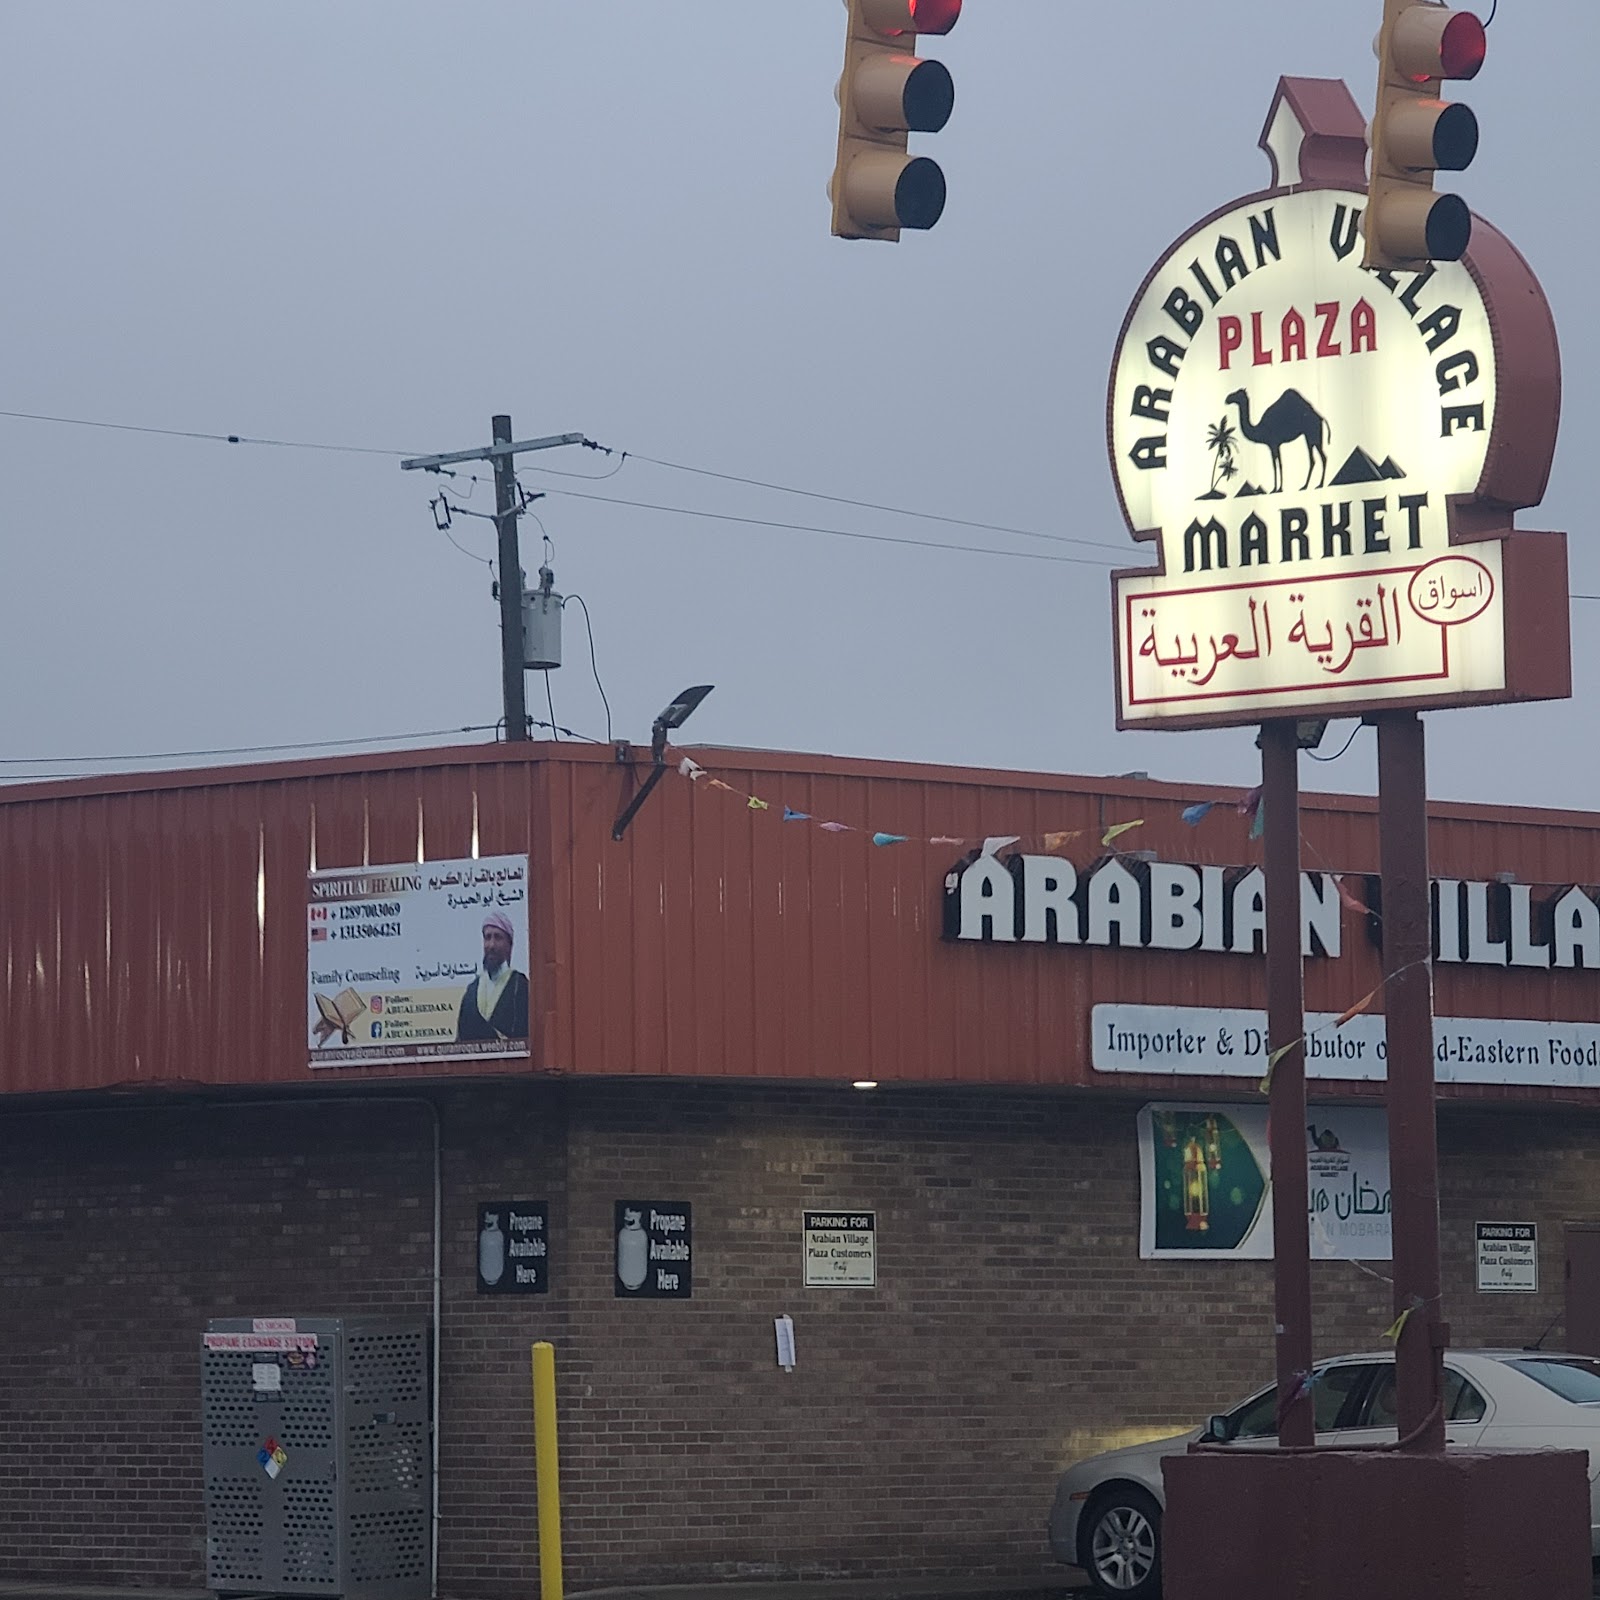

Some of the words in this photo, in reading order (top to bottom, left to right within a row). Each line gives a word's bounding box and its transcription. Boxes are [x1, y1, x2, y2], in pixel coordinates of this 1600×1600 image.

[1128, 207, 1282, 470] ARABIAN
[1218, 296, 1378, 371] PLAZA
[1184, 491, 1429, 571] MARKET
[1418, 572, 1483, 610] اسواق
[1287, 583, 1401, 673] القرية
[1139, 595, 1272, 685] العربية
[312, 879, 368, 898] SPIRITUAL
[371, 875, 422, 893] HEALING
[957, 854, 1341, 958] ARABIAN
[311, 970, 343, 987] Family
[345, 966, 400, 984] Counseling
[1107, 1023, 1206, 1060] Importer
[1217, 1027, 1233, 1055] &
[509, 1211, 544, 1235] Propane
[650, 1209, 686, 1236] Propane
[810, 1216, 847, 1228] PARKING
[850, 1217, 869, 1228] FOR
[1482, 1227, 1513, 1238] PARKING
[1515, 1227, 1531, 1238] FOR
[509, 1237, 546, 1257] Available
[650, 1239, 690, 1261] Available
[811, 1233, 841, 1244] Arabian
[842, 1233, 869, 1246] Village
[808, 1248, 828, 1258] Plaza
[830, 1248, 872, 1259] Customers
[516, 1264, 537, 1283] Here
[657, 1268, 679, 1290] Here
